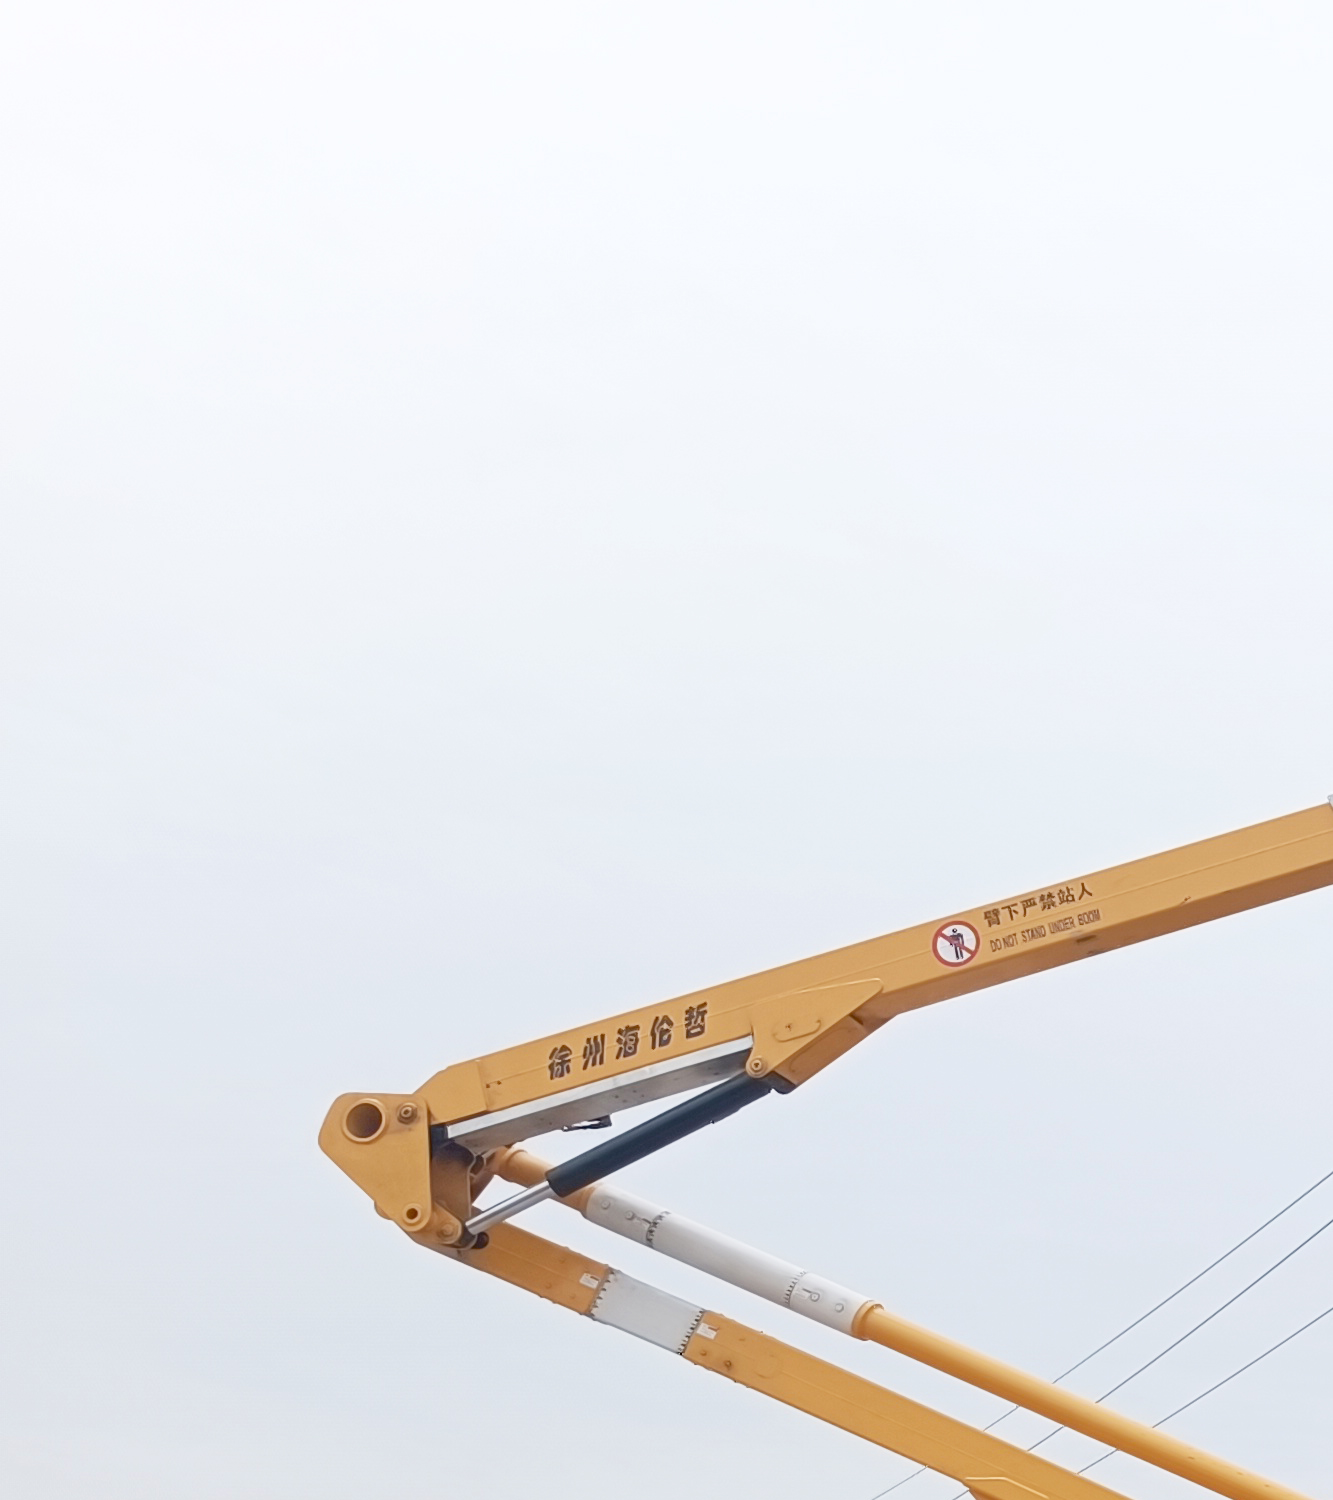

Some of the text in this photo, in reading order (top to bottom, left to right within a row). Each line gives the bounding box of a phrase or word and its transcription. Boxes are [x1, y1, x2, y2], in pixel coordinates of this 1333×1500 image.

[983, 882, 1093, 928] 臂下严禁站人
[990, 939, 1002, 953] DO
[1021, 925, 1047, 943] STAND
[1048, 916, 1076, 934] UNDER
[1078, 909, 1102, 926] BOOM
[548, 1001, 708, 1081] 徐州海伦哲
